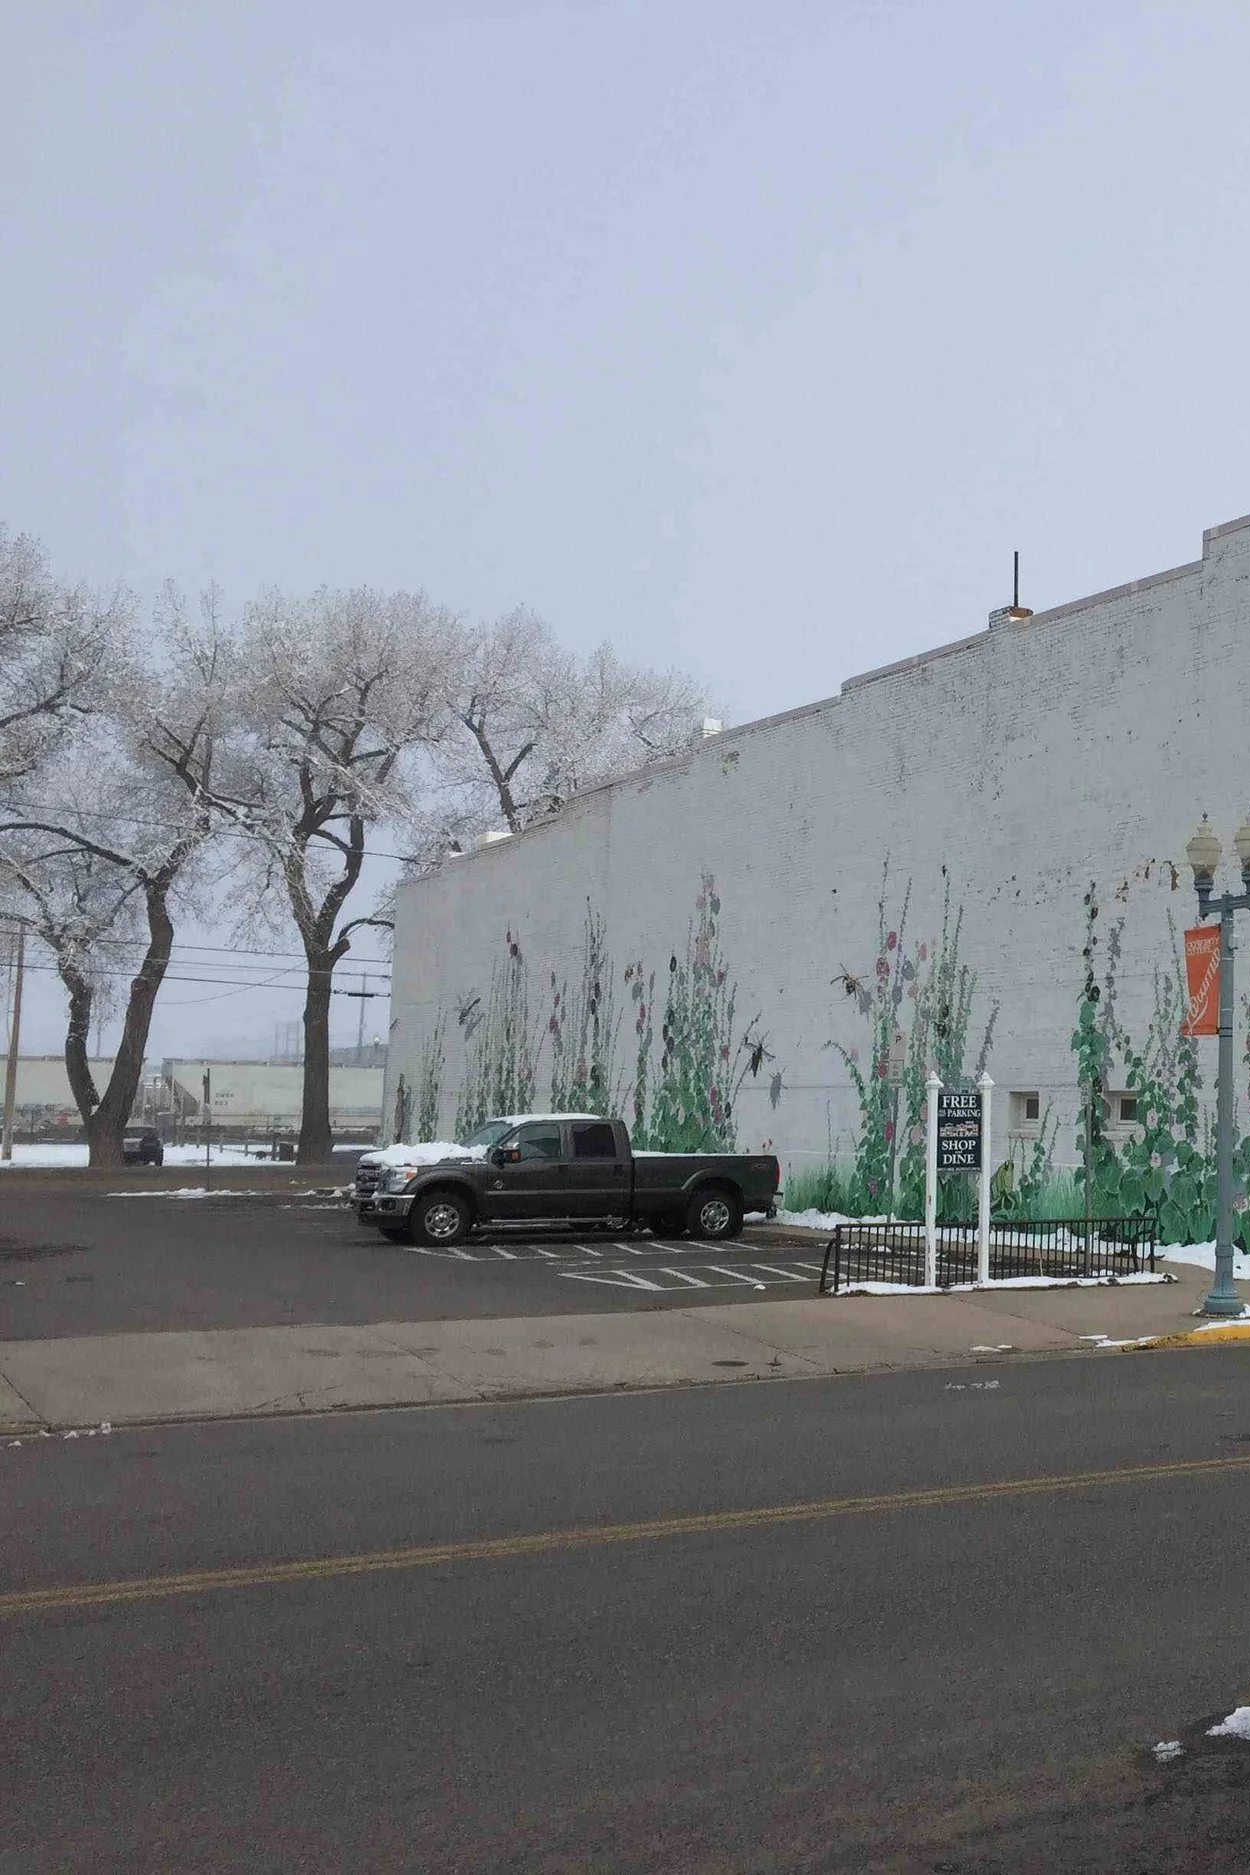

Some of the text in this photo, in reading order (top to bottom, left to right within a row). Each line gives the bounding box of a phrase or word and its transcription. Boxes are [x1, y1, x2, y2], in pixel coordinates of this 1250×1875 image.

[942, 1095, 977, 1108] FREE
[947, 1108, 981, 1118] PARKING
[941, 1139, 976, 1151] SHOP
[943, 1153, 975, 1165] DINE
